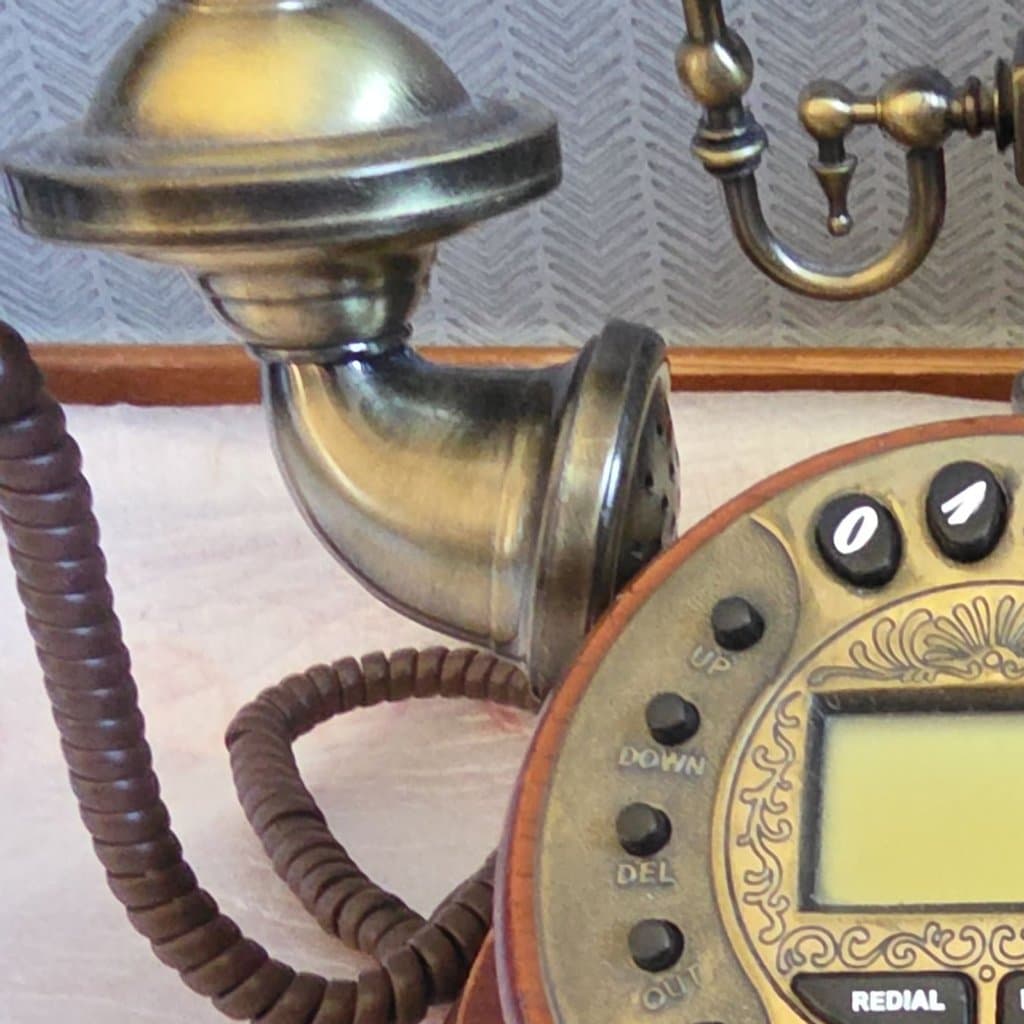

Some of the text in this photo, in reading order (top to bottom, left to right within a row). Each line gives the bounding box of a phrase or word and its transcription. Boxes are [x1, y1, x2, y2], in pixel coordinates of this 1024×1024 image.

[940, 480, 987, 526] 1
[832, 505, 879, 555] 0
[689, 646, 732, 675] UP
[617, 746, 707, 776] DOWN
[615, 860, 676, 886] DEL
[642, 964, 702, 1011] OUT
[851, 988, 947, 1013] REDIAL
